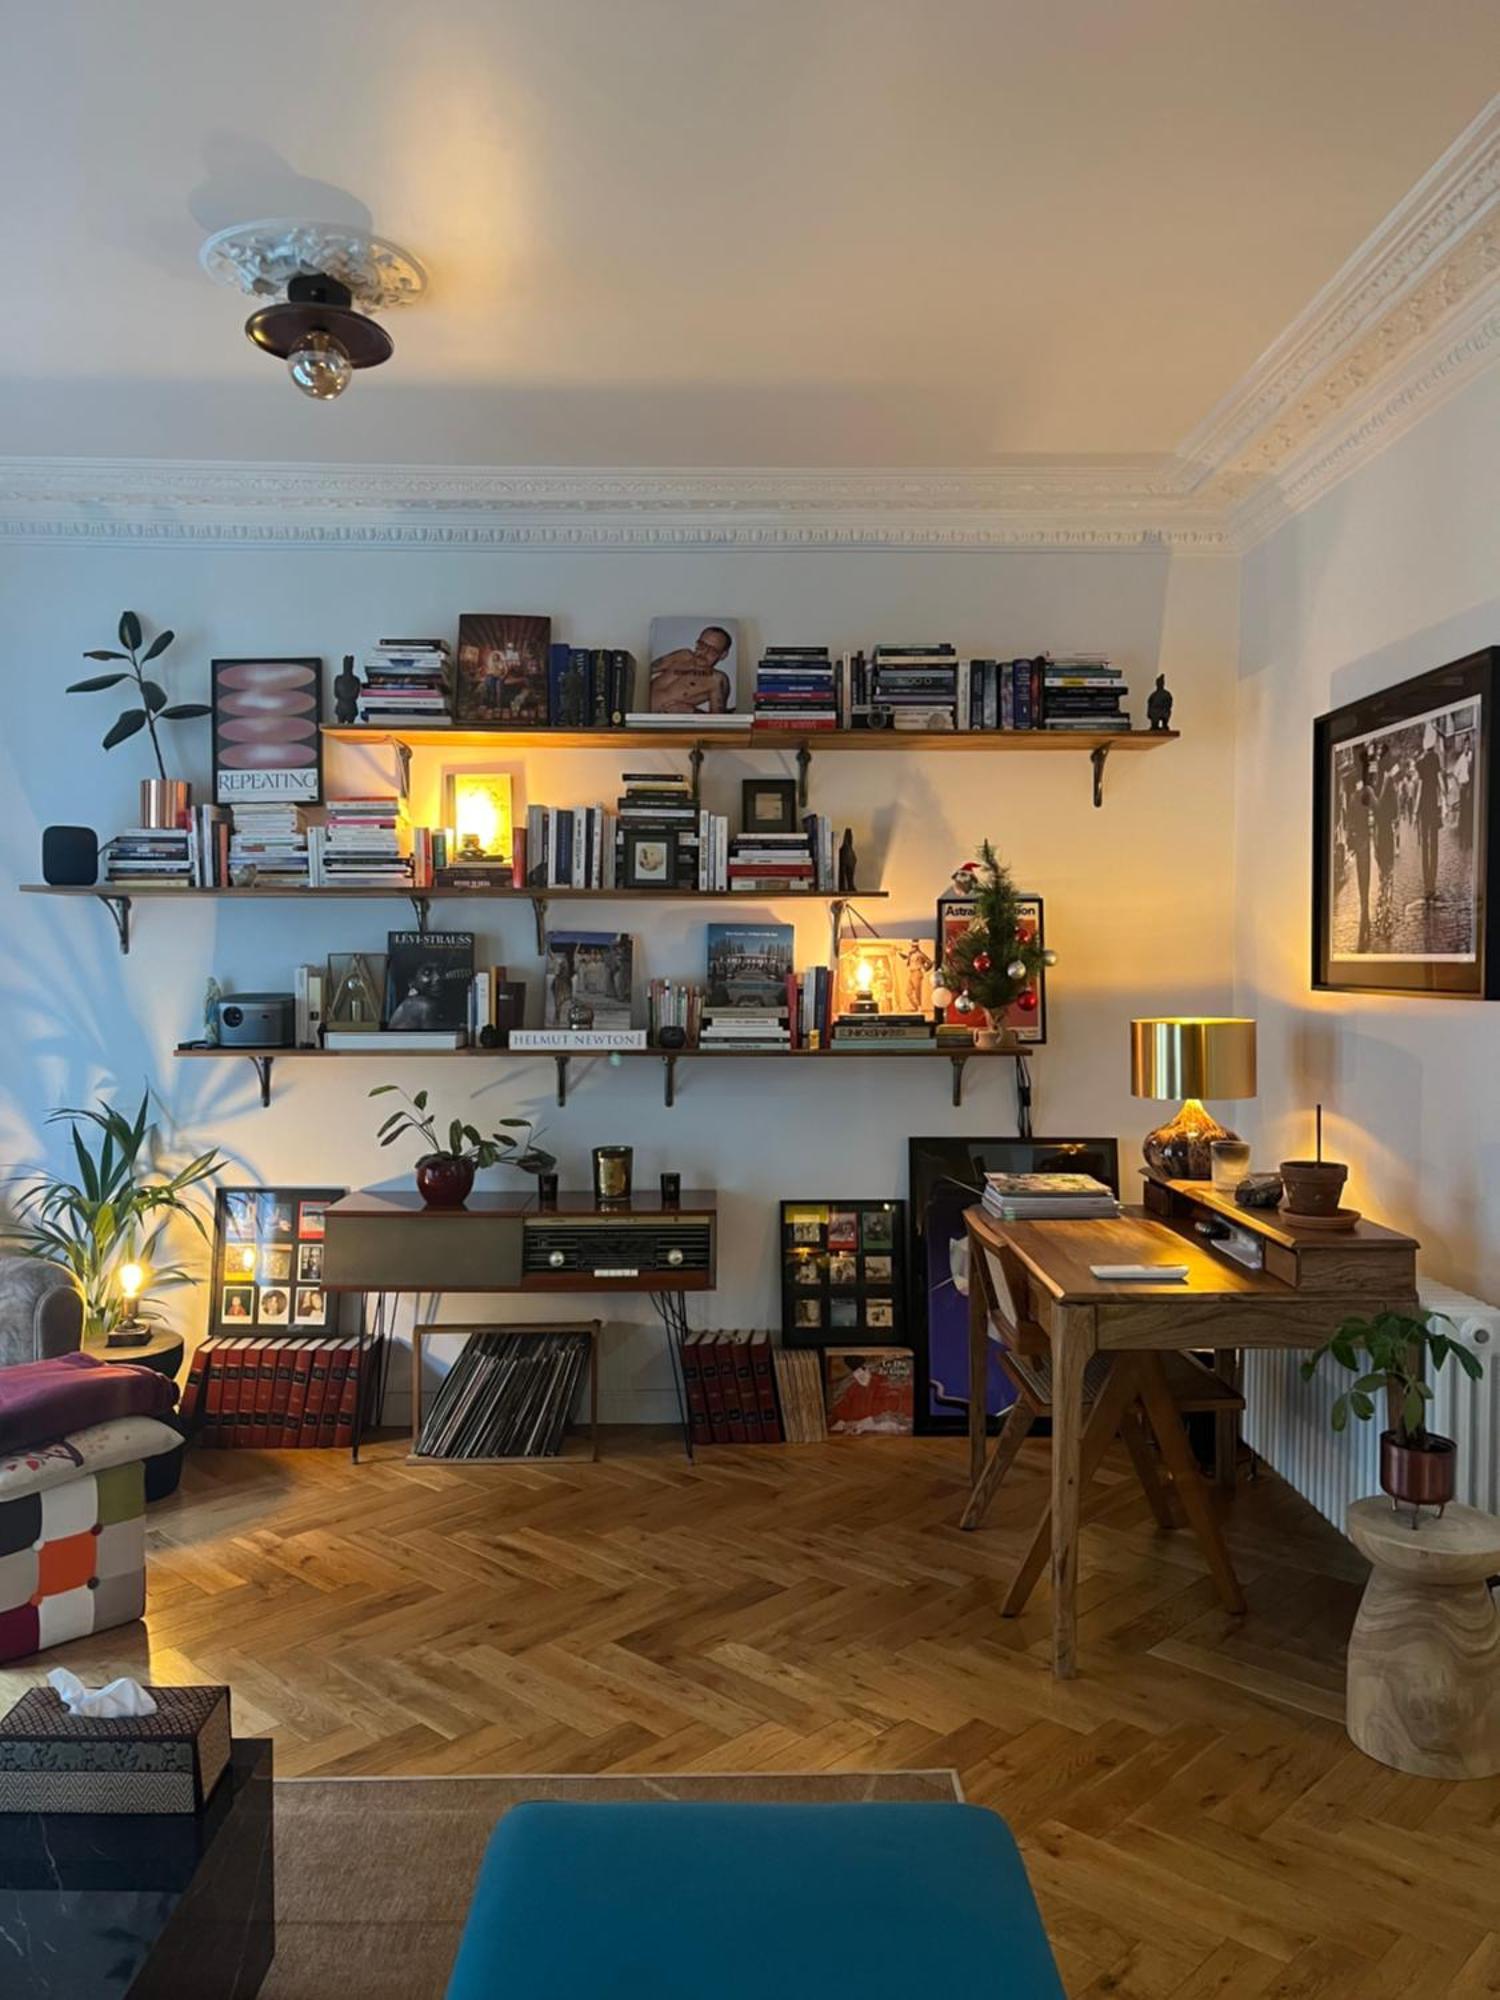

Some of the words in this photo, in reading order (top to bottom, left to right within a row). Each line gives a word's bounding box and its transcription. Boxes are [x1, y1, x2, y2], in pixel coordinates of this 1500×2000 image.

[219, 772, 317, 791] REPEATING
[513, 1034, 568, 1046] HELMUT
[574, 1034, 635, 1046] NEWTON
